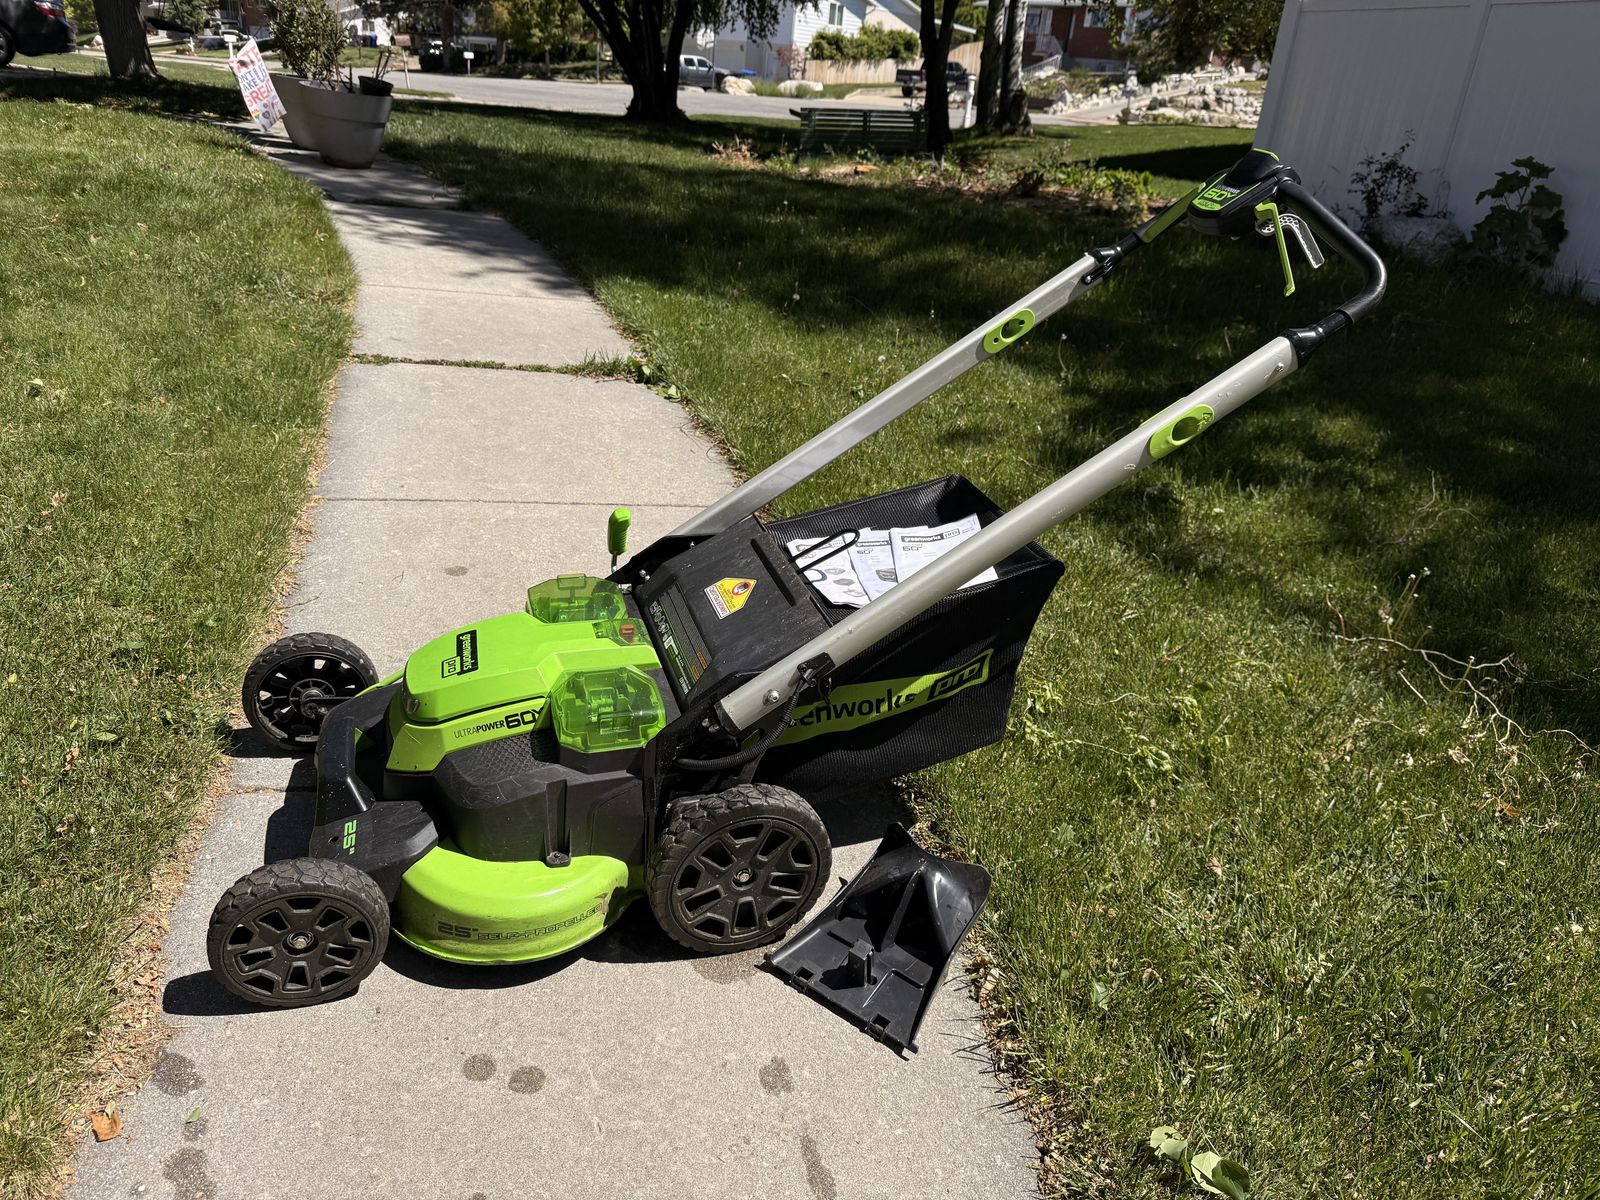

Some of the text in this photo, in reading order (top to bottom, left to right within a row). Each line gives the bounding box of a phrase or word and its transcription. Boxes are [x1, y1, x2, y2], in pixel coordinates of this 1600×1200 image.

[242, 79, 259, 91] AKE
[460, 633, 474, 671] greenworks
[788, 662, 981, 728] enworks pro
[453, 719, 505, 739] ULTRAPOWER
[343, 820, 357, 855] 25"
[437, 920, 479, 939] 25"
